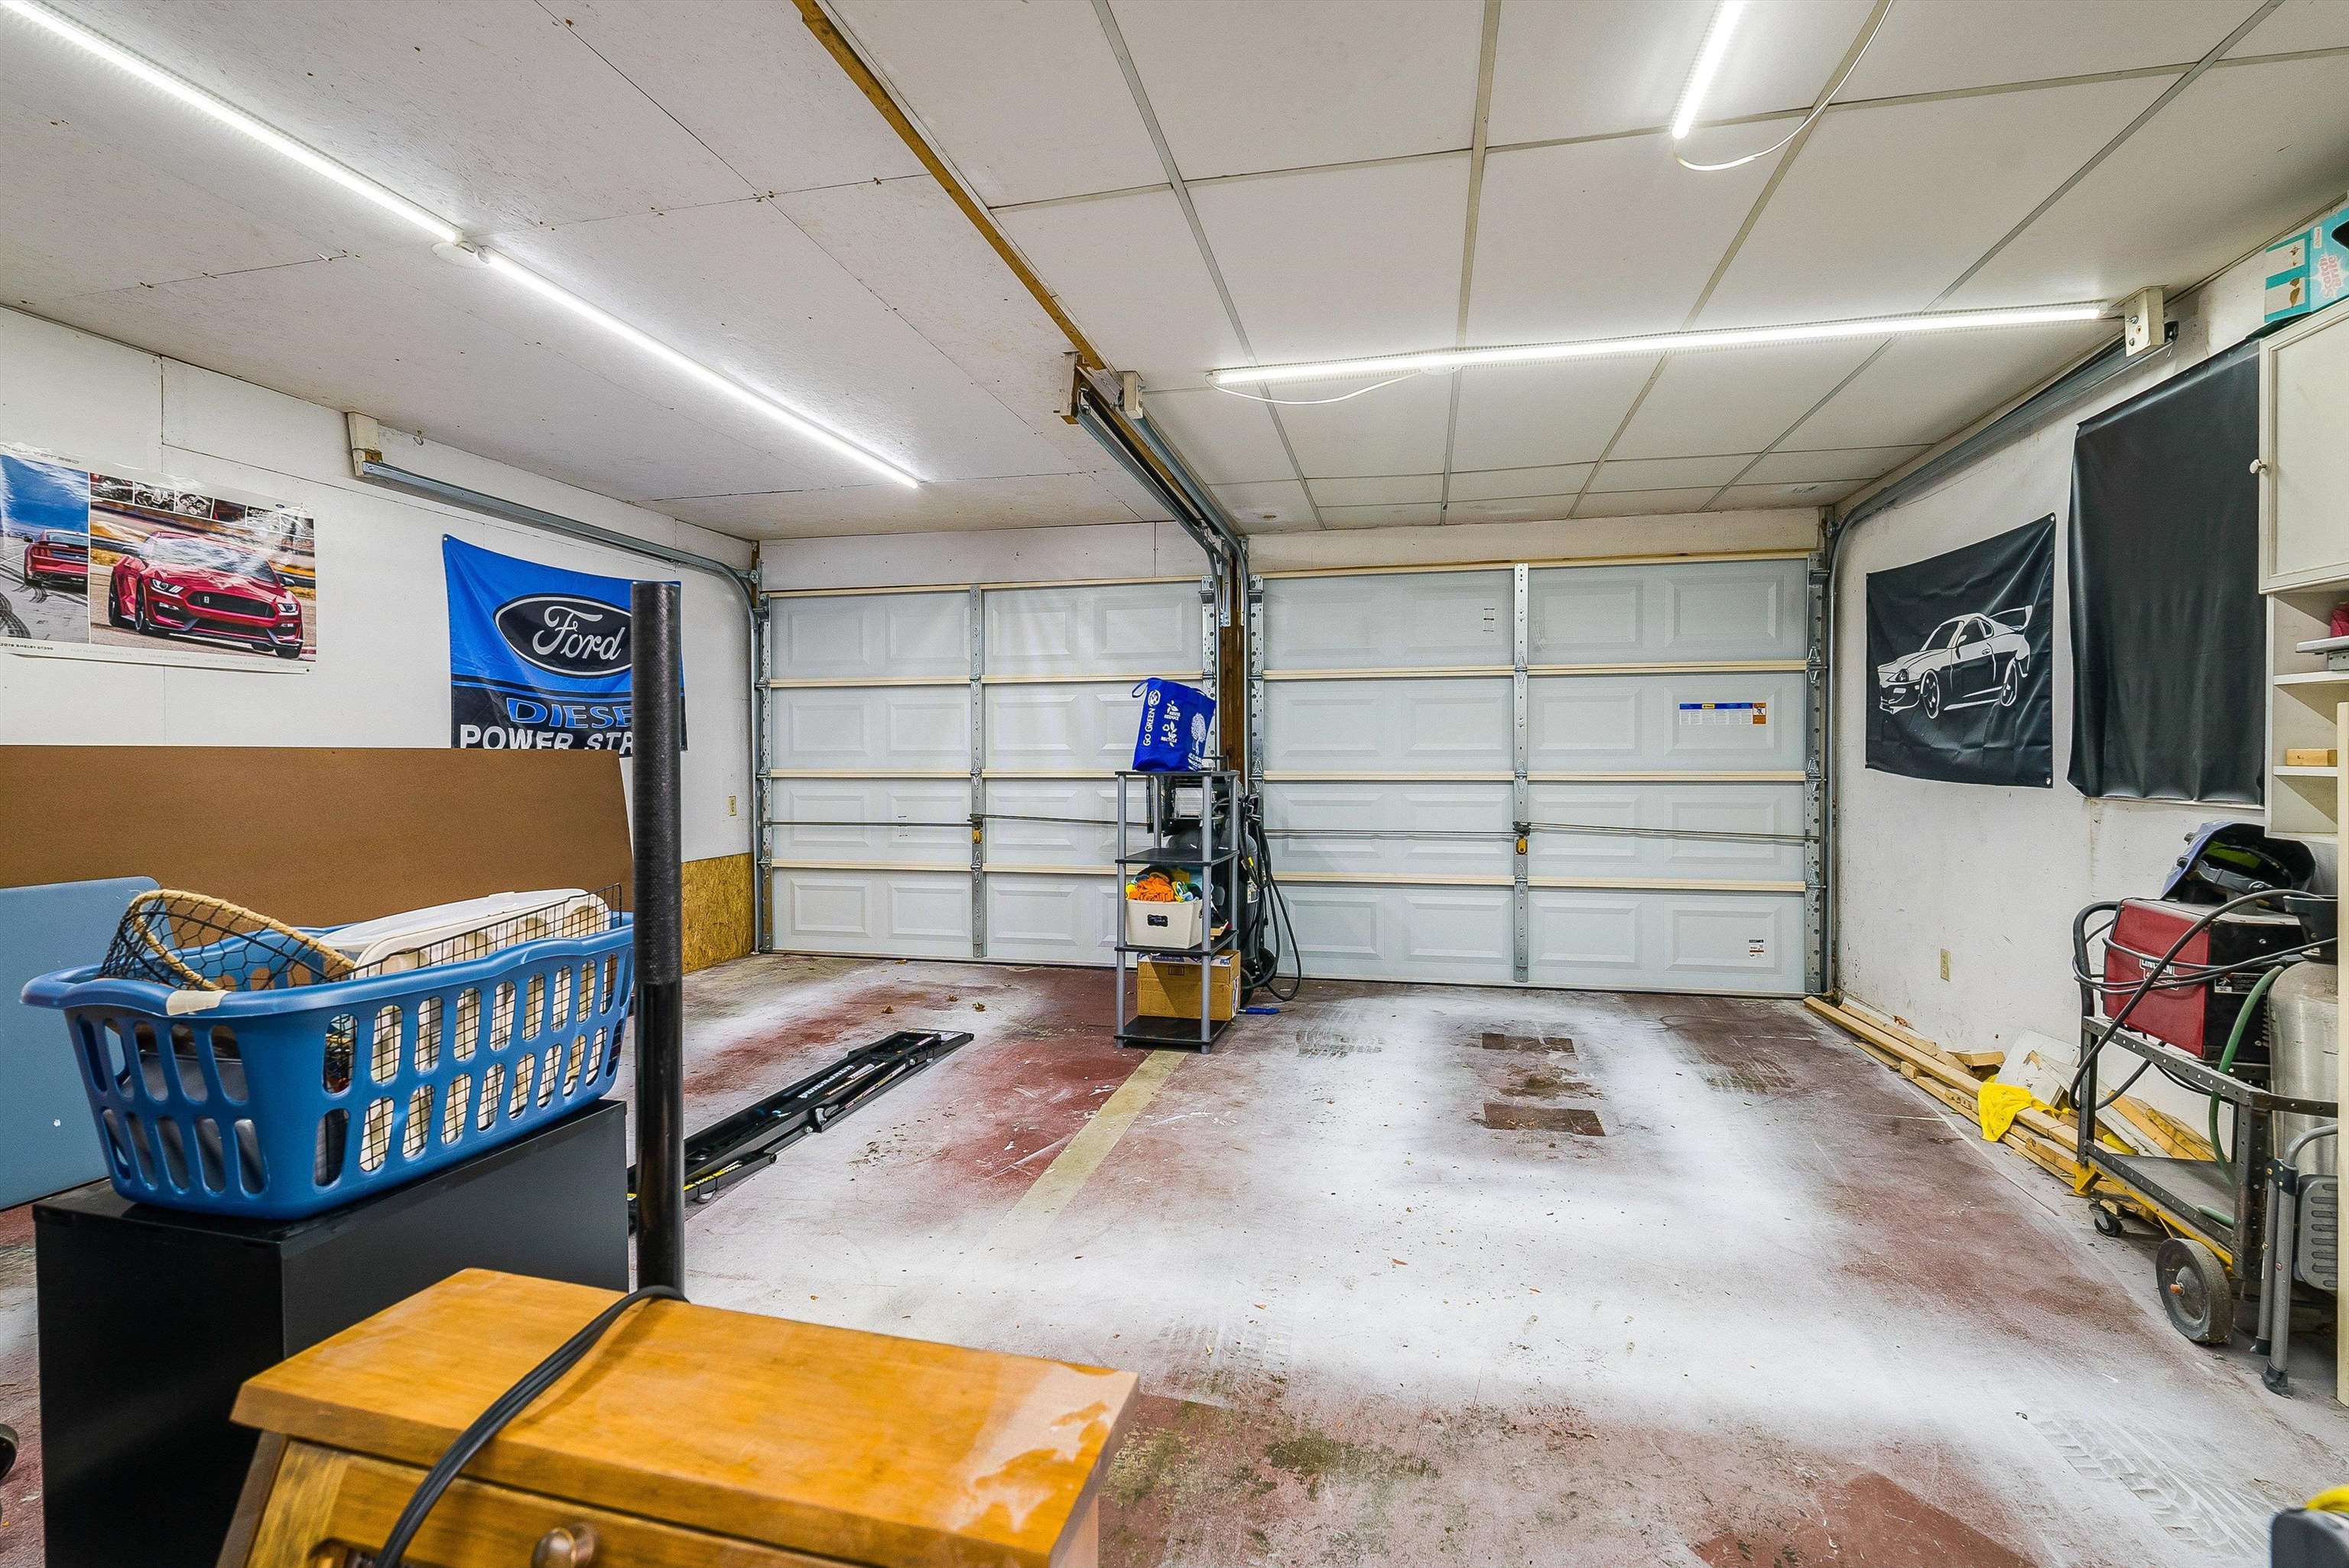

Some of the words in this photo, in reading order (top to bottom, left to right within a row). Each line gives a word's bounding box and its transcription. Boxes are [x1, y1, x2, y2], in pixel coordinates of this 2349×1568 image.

[532, 605, 625, 660] Ford
[506, 697, 633, 729] DIESE
[1145, 707, 1155, 732] GREEN
[460, 724, 573, 750] POWER
[584, 732, 633, 755] STR
[1142, 733, 1152, 746] GO
